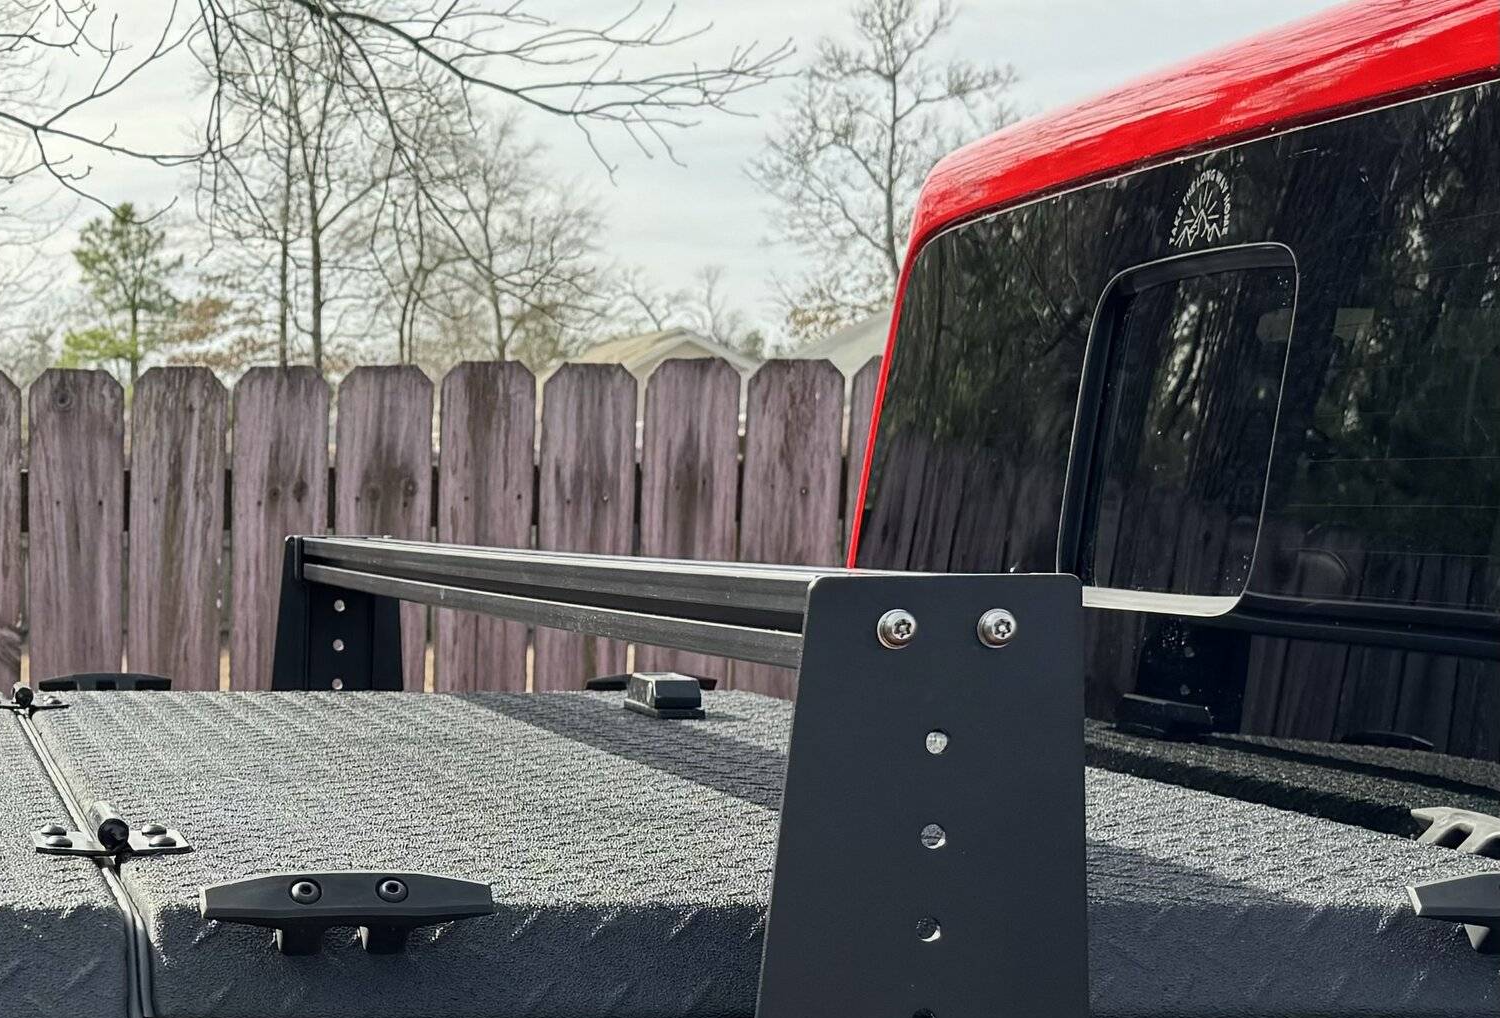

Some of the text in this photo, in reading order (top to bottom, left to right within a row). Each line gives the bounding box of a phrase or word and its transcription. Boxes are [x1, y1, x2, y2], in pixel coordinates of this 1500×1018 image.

[1168, 168, 1231, 245] TAKE THE LONG WAY HOME
